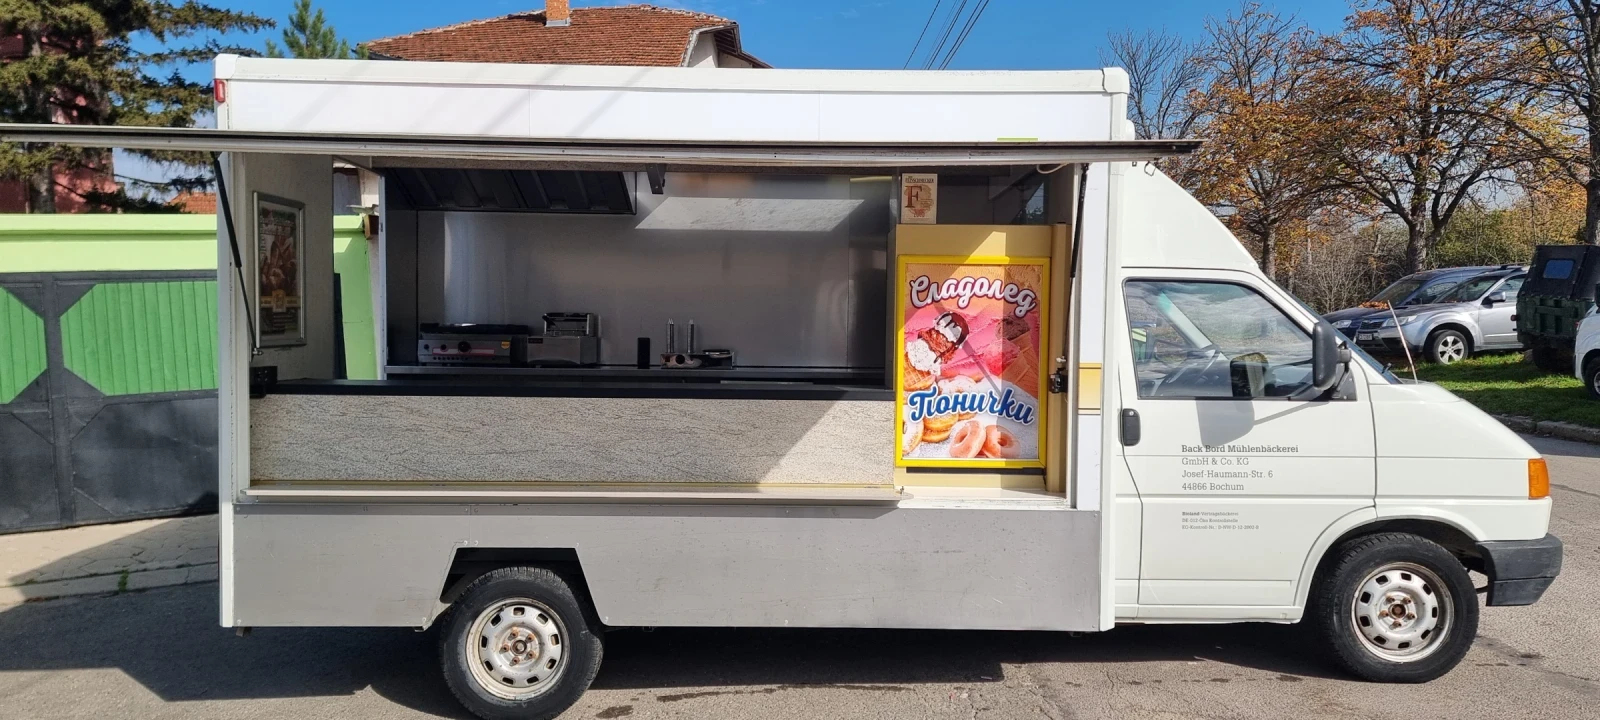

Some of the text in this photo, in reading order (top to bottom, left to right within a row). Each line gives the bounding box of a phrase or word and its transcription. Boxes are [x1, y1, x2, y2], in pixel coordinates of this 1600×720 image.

[904, 185, 923, 208] F
[909, 275, 1037, 318] Сладолед
[908, 385, 1035, 424] Понички
[1181, 445, 1299, 453] Back Bord Mühlenbäckerei
[1181, 457, 1250, 465] GmbH & Co. KG
[1181, 470, 1274, 478] Josef-Haumann-Str. 6
